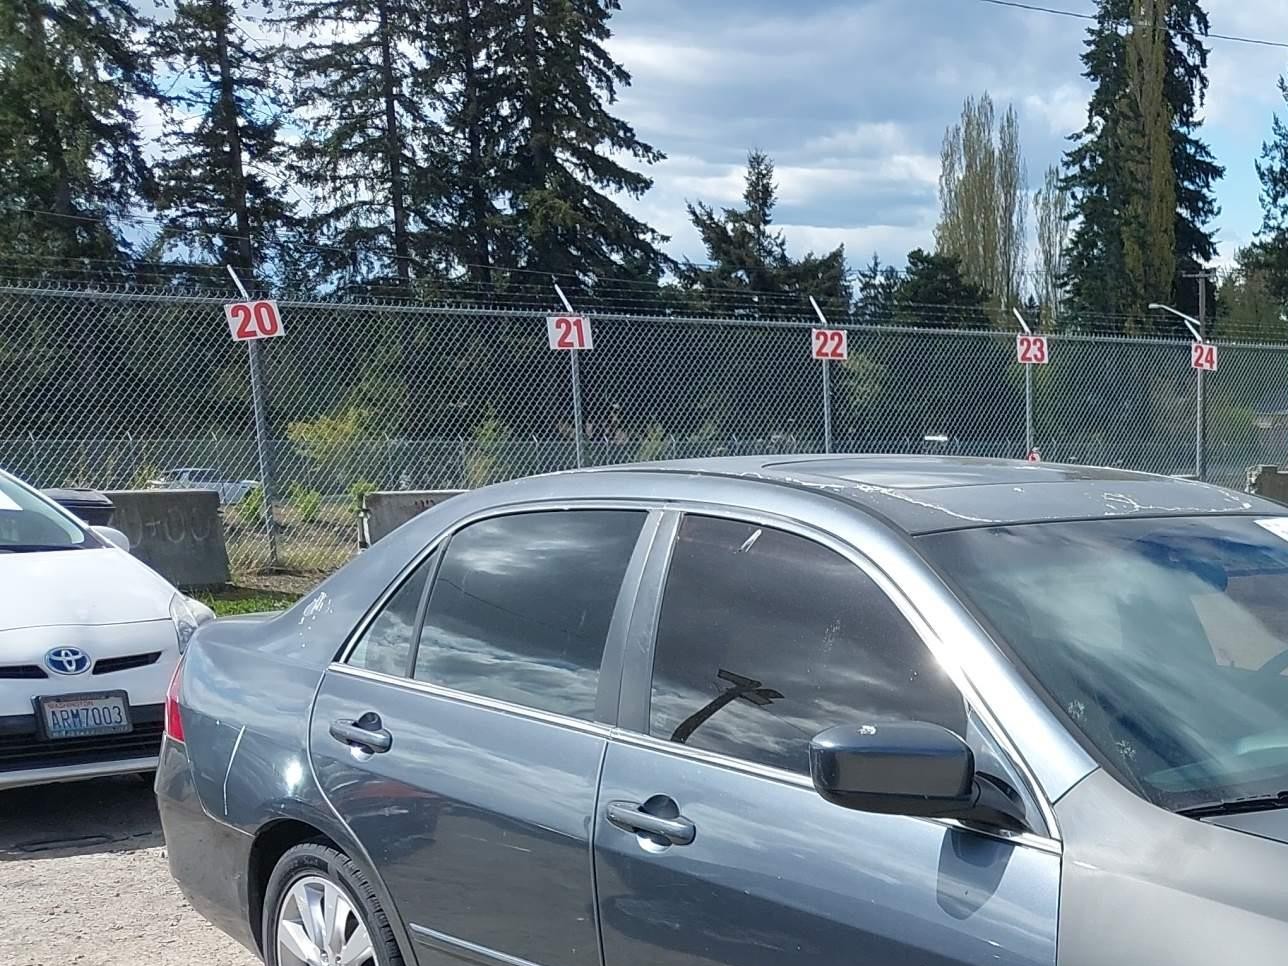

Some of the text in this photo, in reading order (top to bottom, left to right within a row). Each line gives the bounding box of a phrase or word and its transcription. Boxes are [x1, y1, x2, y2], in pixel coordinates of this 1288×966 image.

[230, 302, 279, 339] 20
[555, 318, 585, 348] 21
[815, 331, 844, 359] 22
[1020, 337, 1045, 362] 23
[1194, 345, 1216, 369] 24
[50, 705, 124, 730] ARM7003
